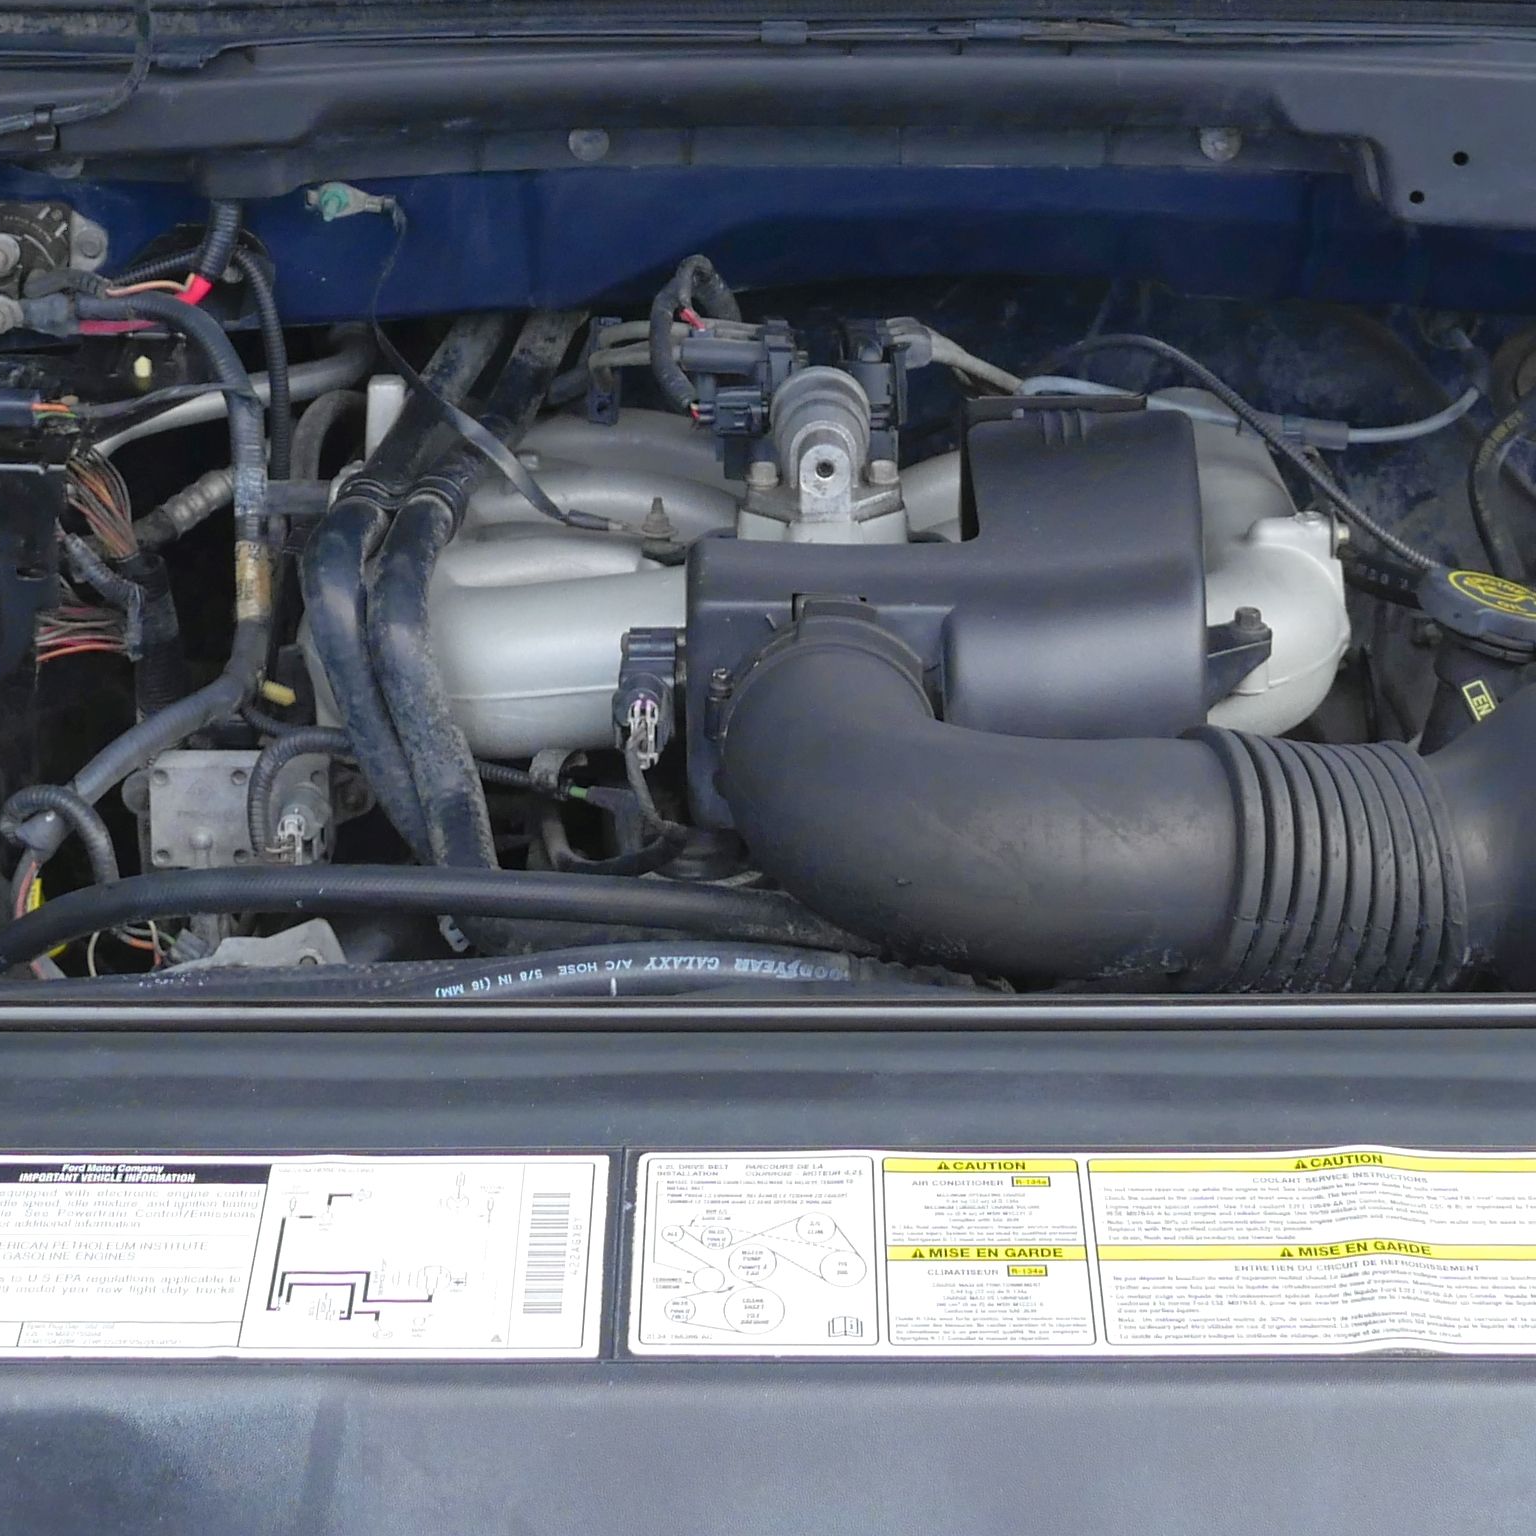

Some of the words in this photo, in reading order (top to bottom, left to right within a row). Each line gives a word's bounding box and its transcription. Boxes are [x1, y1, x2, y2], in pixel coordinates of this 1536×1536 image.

[604, 957, 633, 971] A/C
[643, 954, 720, 972] GALAXY
[556, 961, 599, 977] HOSE
[497, 973, 513, 986] IN
[519, 967, 543, 982] 5/8
[953, 1162, 1026, 1170] CAUTION
[1310, 1155, 1383, 1168] CAUTION
[62, 1164, 85, 1172] Ford
[87, 1164, 116, 1172] Motor
[118, 1165, 164, 1173] Company
[19, 1173, 79, 1182] IMPORTANT
[81, 1174, 122, 1182] VEHICLE
[125, 1174, 195, 1183] INFORMATION
[1252, 1175, 1302, 1184] COOLANT
[1305, 1172, 1350, 1183] SERVICE
[1352, 1171, 1429, 1184] INSTRUCTIONS
[0, 1189, 57, 1199] equipped
[64, 1189, 90, 1197] with
[96, 1189, 159, 1197] electronic
[166, 1190, 209, 1199] engine
[216, 1190, 260, 1198] control
[58, 1209, 127, 1218] Powertrain
[53, 1241, 136, 1250] PETROLEUM
[140, 1242, 208, 1251] INSTITUTE
[1298, 1245, 1340, 1257] MISE
[1346, 1242, 1369, 1254] EN
[1373, 1242, 1432, 1256] GARDE
[2, 1252, 70, 1261] GASOLINE
[75, 1252, 136, 1261] ENGINES
[929, 1248, 970, 1258] MISE
[976, 1248, 999, 1258] EN
[1005, 1248, 1063, 1258] GARDE
[86, 1274, 155, 1284] regulations
[160, 1275, 224, 1284] applicable
